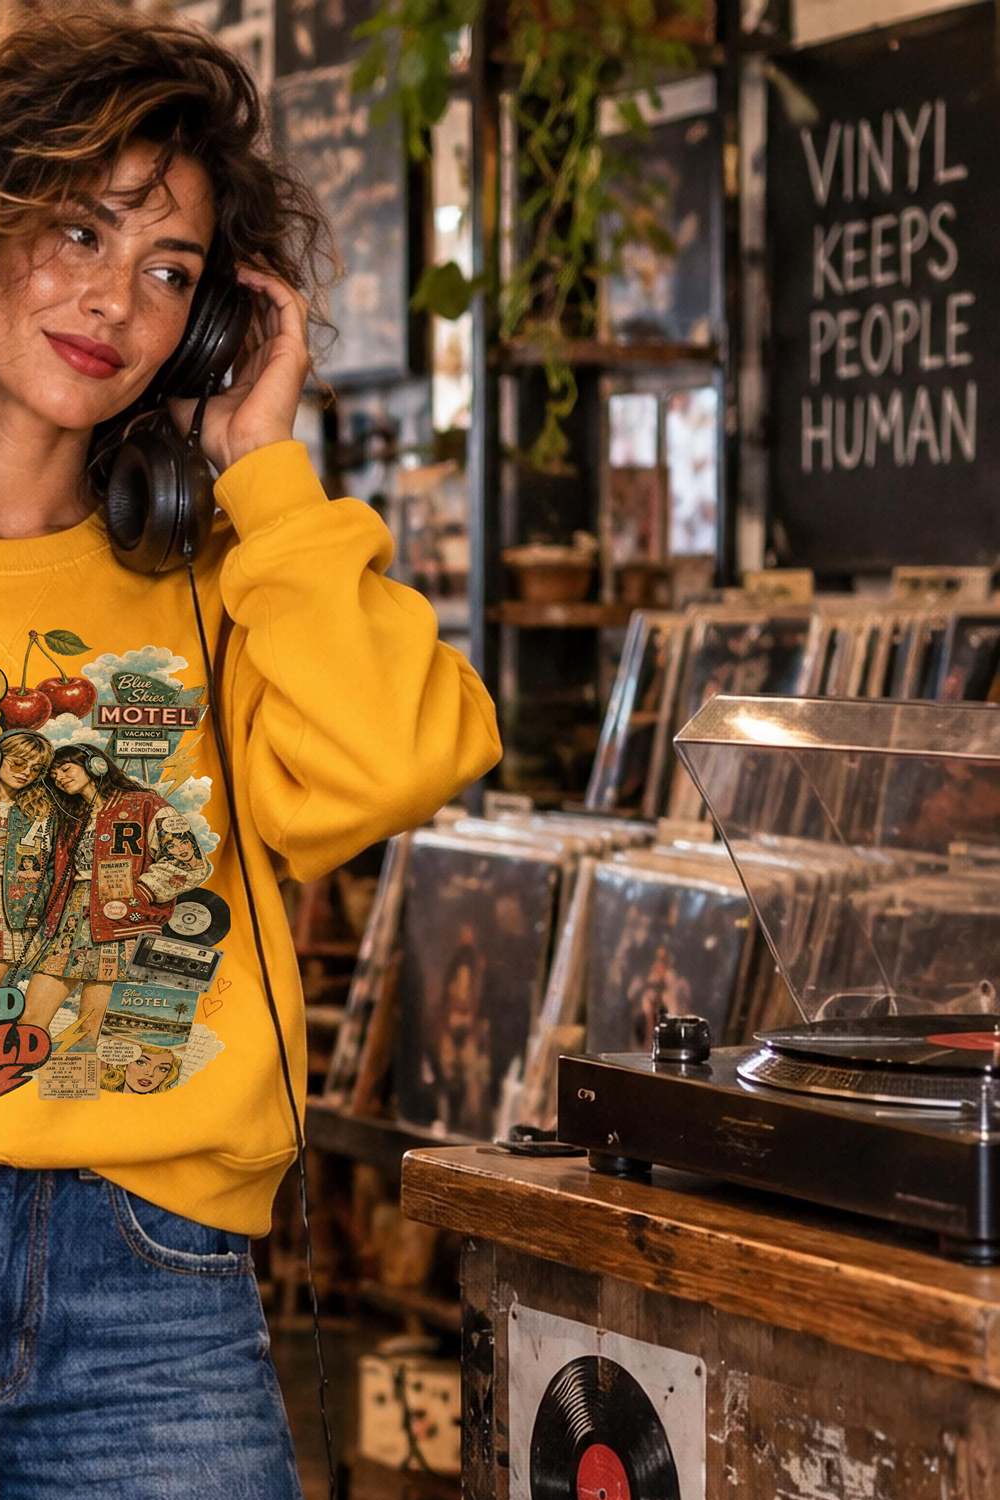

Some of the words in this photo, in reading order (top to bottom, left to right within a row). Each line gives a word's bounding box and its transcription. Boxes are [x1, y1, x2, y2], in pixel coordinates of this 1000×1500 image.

[801, 99, 968, 207] VINYL
[812, 201, 959, 301] KEEPS
[809, 291, 976, 384] PEOPLE
[800, 379, 978, 473] HUMAN
[117, 674, 153, 690] Blue
[127, 688, 165, 703] Skies
[100, 706, 194, 726] MOTEL
[124, 730, 161, 738] VACANCY
[110, 821, 144, 857] R
[120, 997, 171, 1008] MOTEL
[122, 988, 142, 998] Blue
